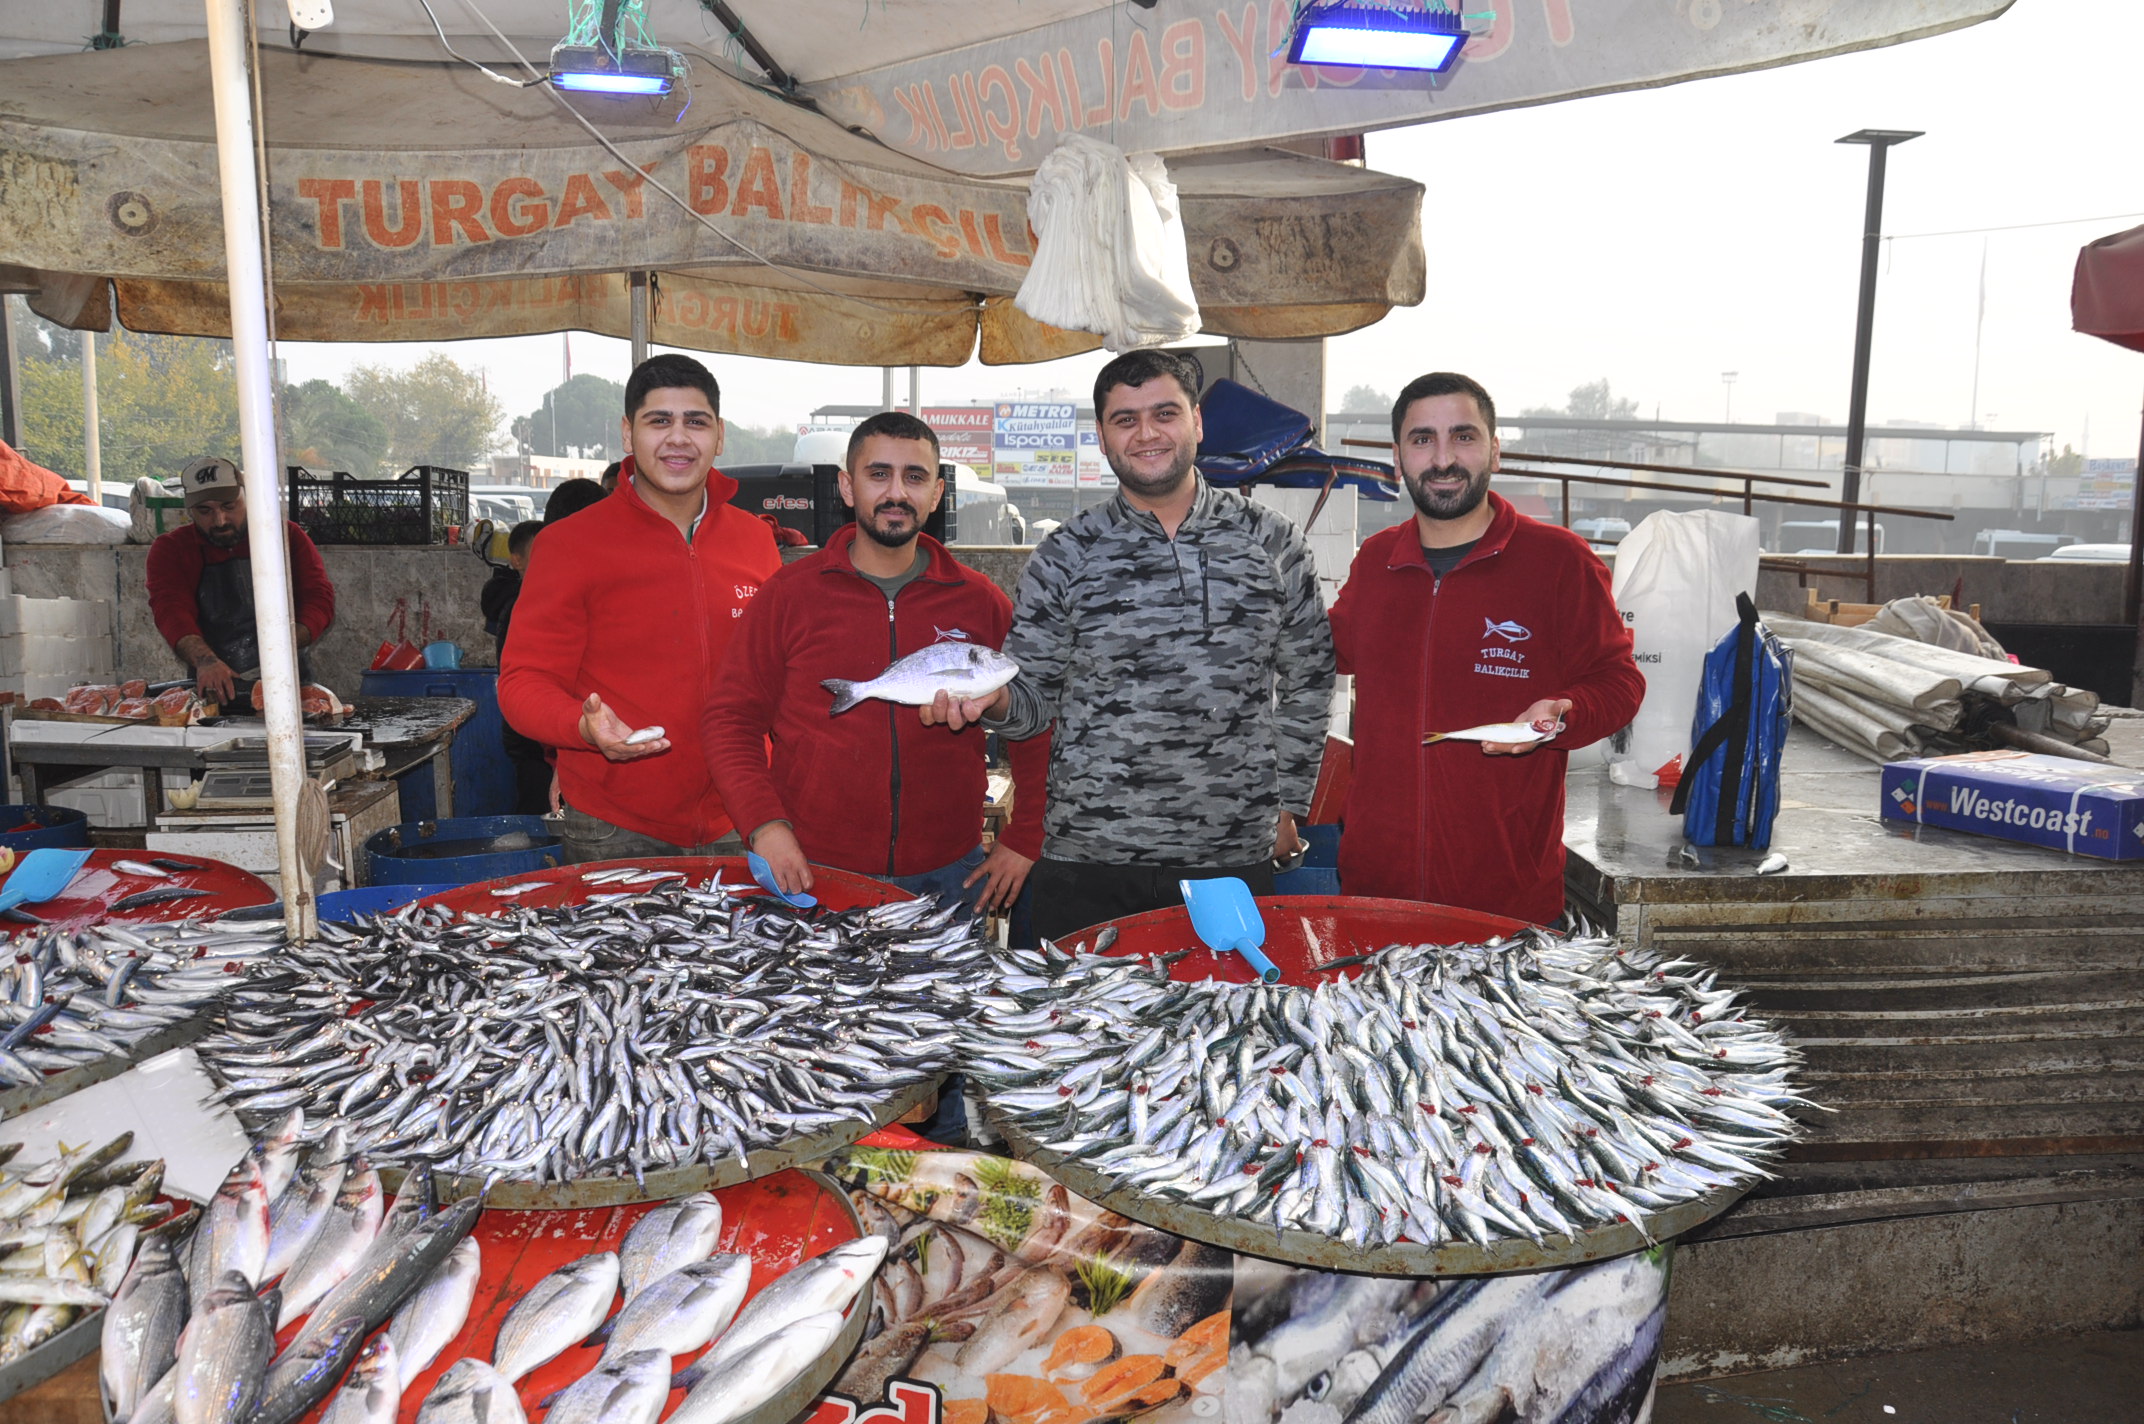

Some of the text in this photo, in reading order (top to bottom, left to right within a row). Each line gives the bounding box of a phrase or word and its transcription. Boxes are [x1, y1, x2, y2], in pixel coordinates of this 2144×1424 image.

[299, 144, 1038, 267] TURGAY BALIKÇIL
[920, 413, 989, 425] AMUKKALE
[1013, 405, 1072, 418] METRO
[1004, 433, 1065, 449] Isparta
[763, 494, 809, 510] efes
[1480, 647, 1526, 663] TURGAY
